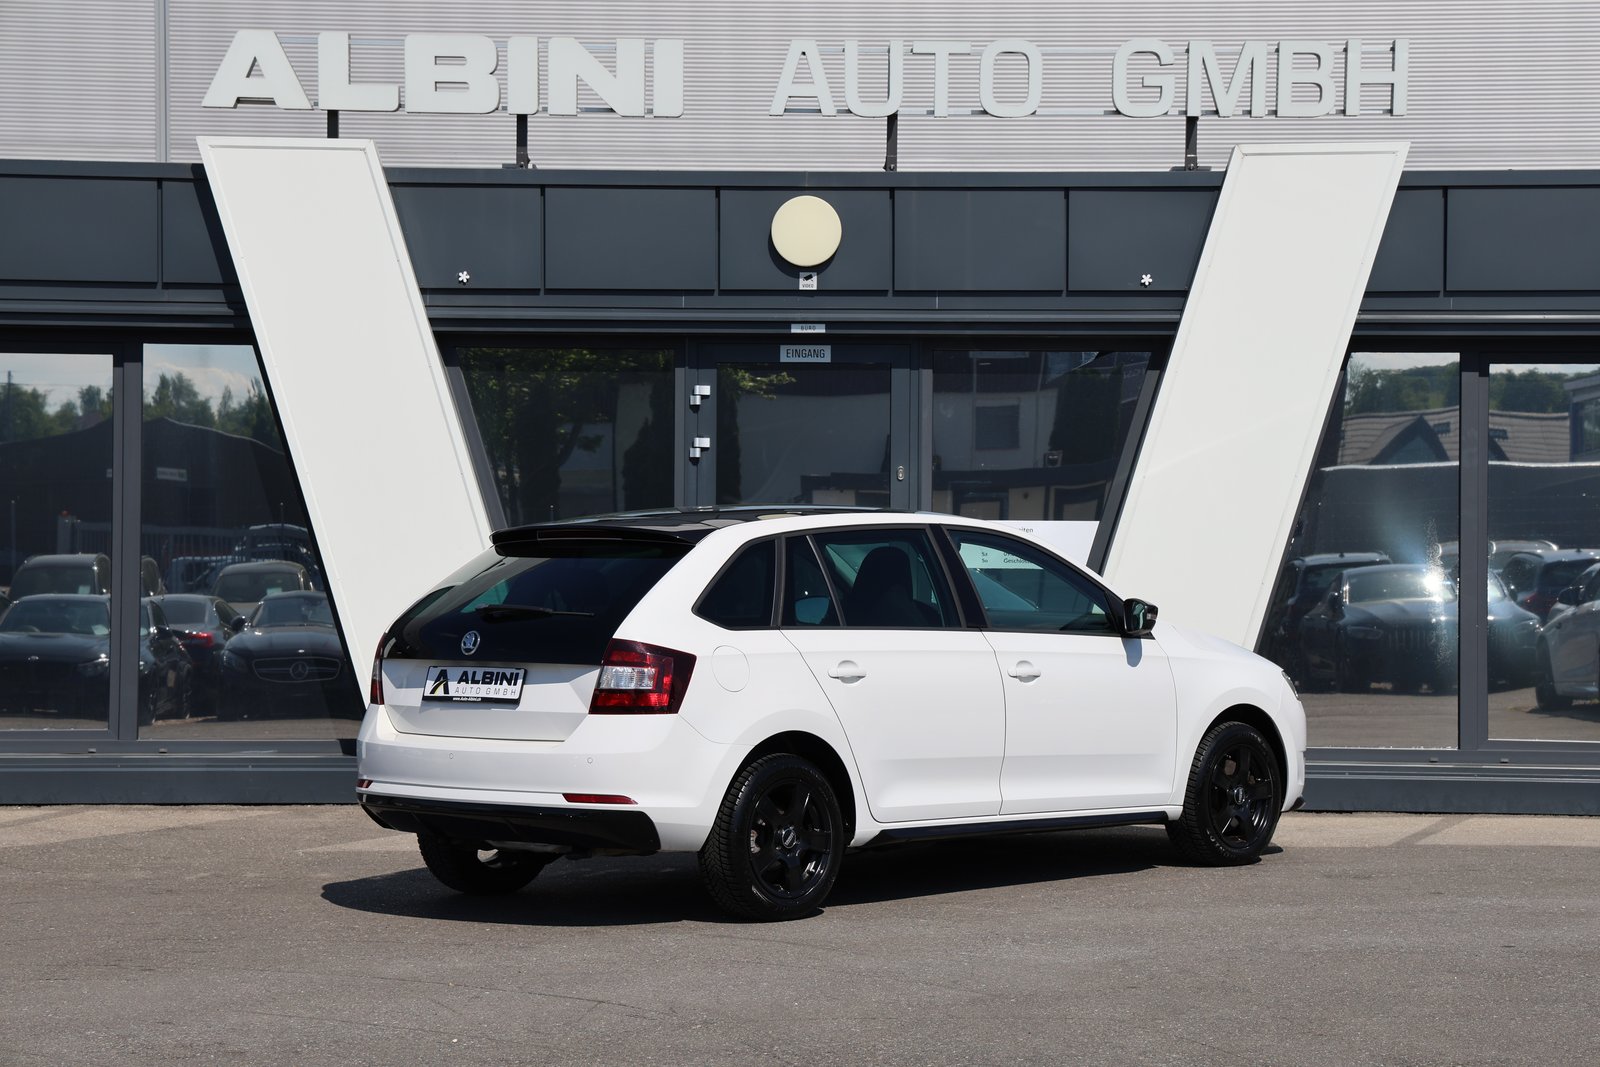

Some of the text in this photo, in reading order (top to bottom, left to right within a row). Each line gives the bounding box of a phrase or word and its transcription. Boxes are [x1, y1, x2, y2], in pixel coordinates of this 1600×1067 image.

[202, 29, 1410, 118] ALBINI AUTO GMBH
[786, 349, 825, 358] EINGANG
[457, 670, 520, 686] ALBINI
[455, 687, 517, 696] AUTO GMBH
